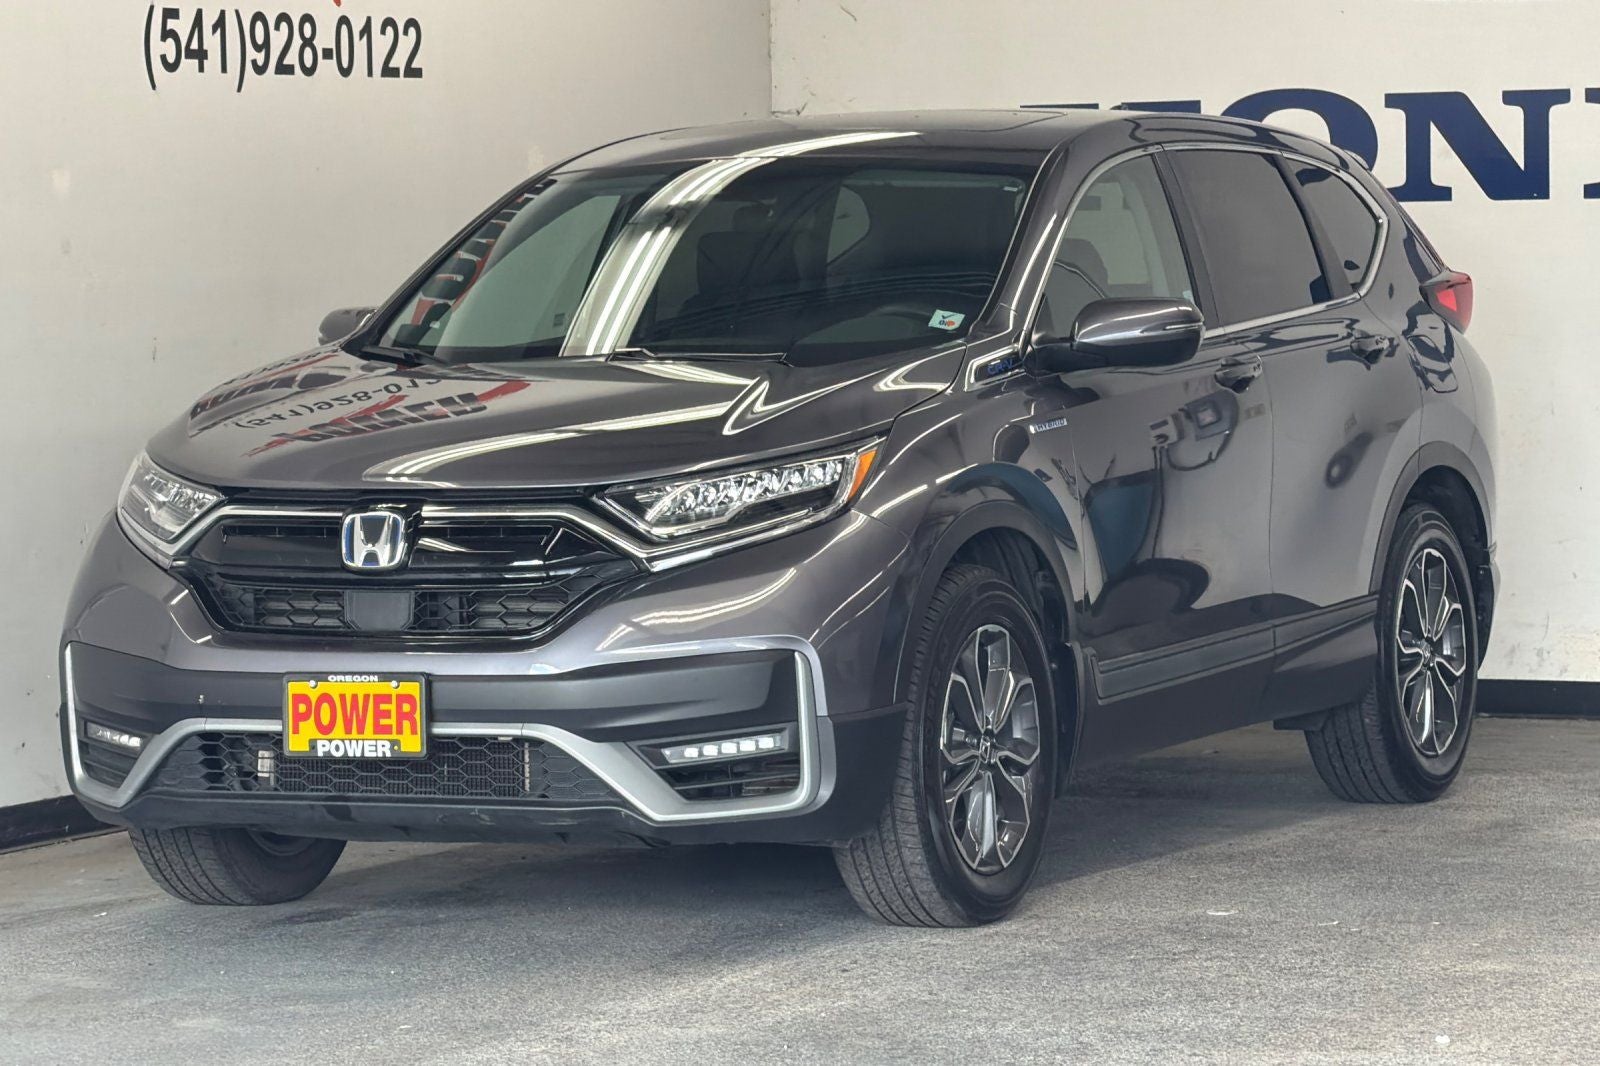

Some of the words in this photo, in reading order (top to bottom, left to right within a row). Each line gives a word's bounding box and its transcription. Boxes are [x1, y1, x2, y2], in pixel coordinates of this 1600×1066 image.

[143, 4, 423, 93] (541)928-0122
[291, 692, 419, 736] POWER
[316, 739, 392, 758] POWER
